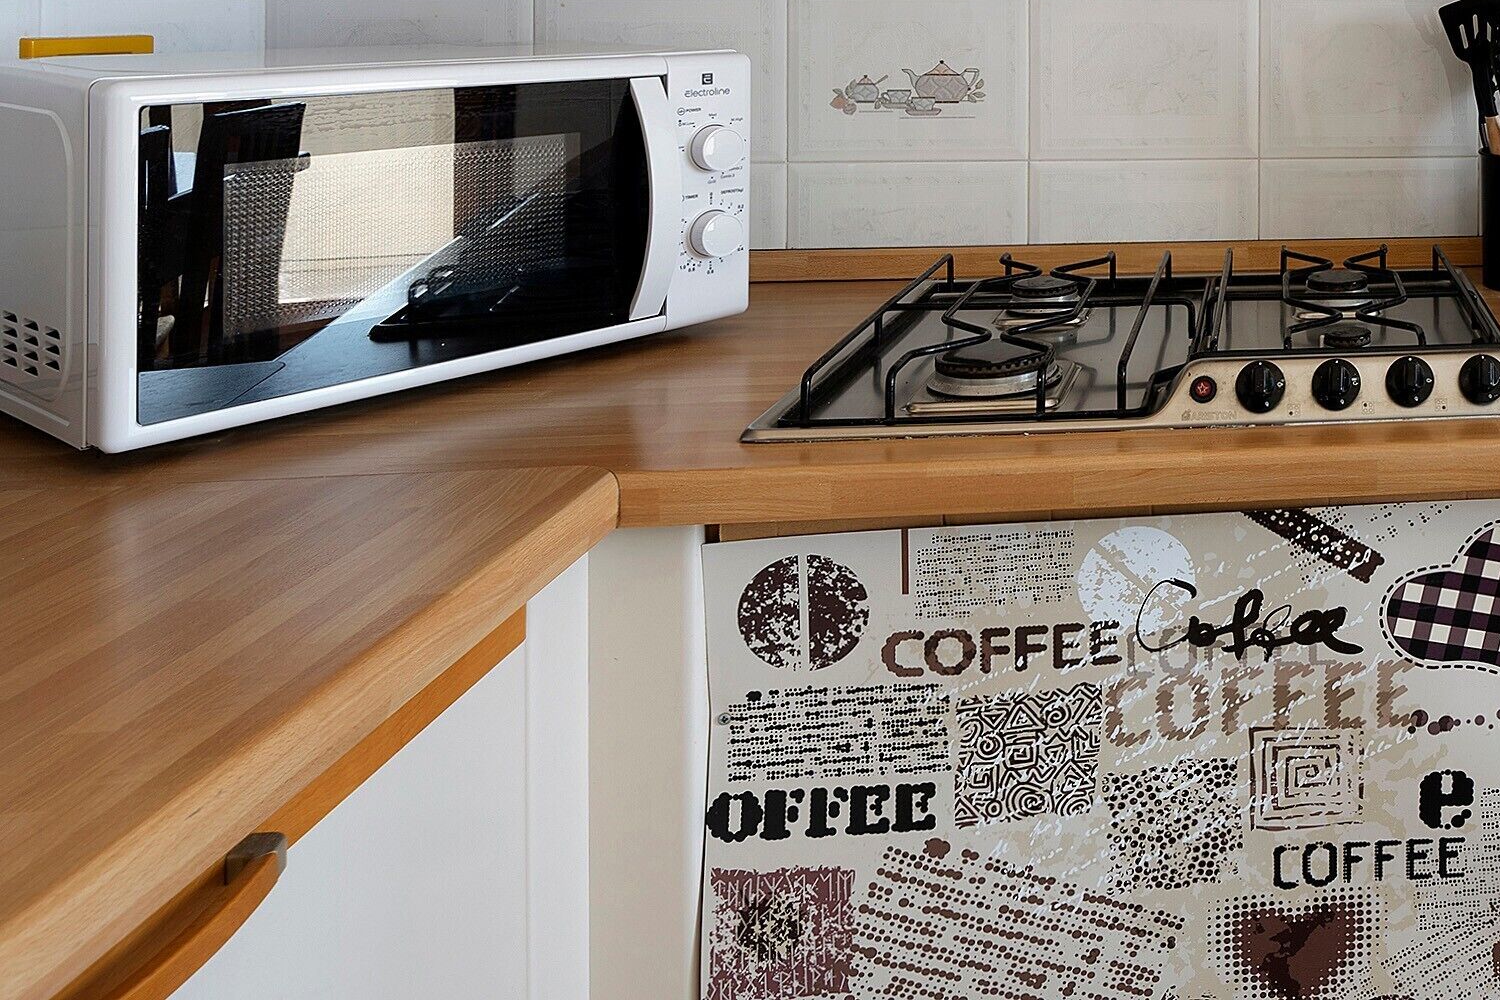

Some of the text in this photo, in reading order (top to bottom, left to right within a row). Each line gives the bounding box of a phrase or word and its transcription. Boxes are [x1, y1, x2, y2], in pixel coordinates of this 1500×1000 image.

[881, 618, 1122, 678] COFFEE
[1104, 659, 1417, 748] COFFEE
[706, 781, 937, 843] OFFEE
[1419, 768, 1475, 830] e
[1272, 837, 1466, 891] COFFEE
